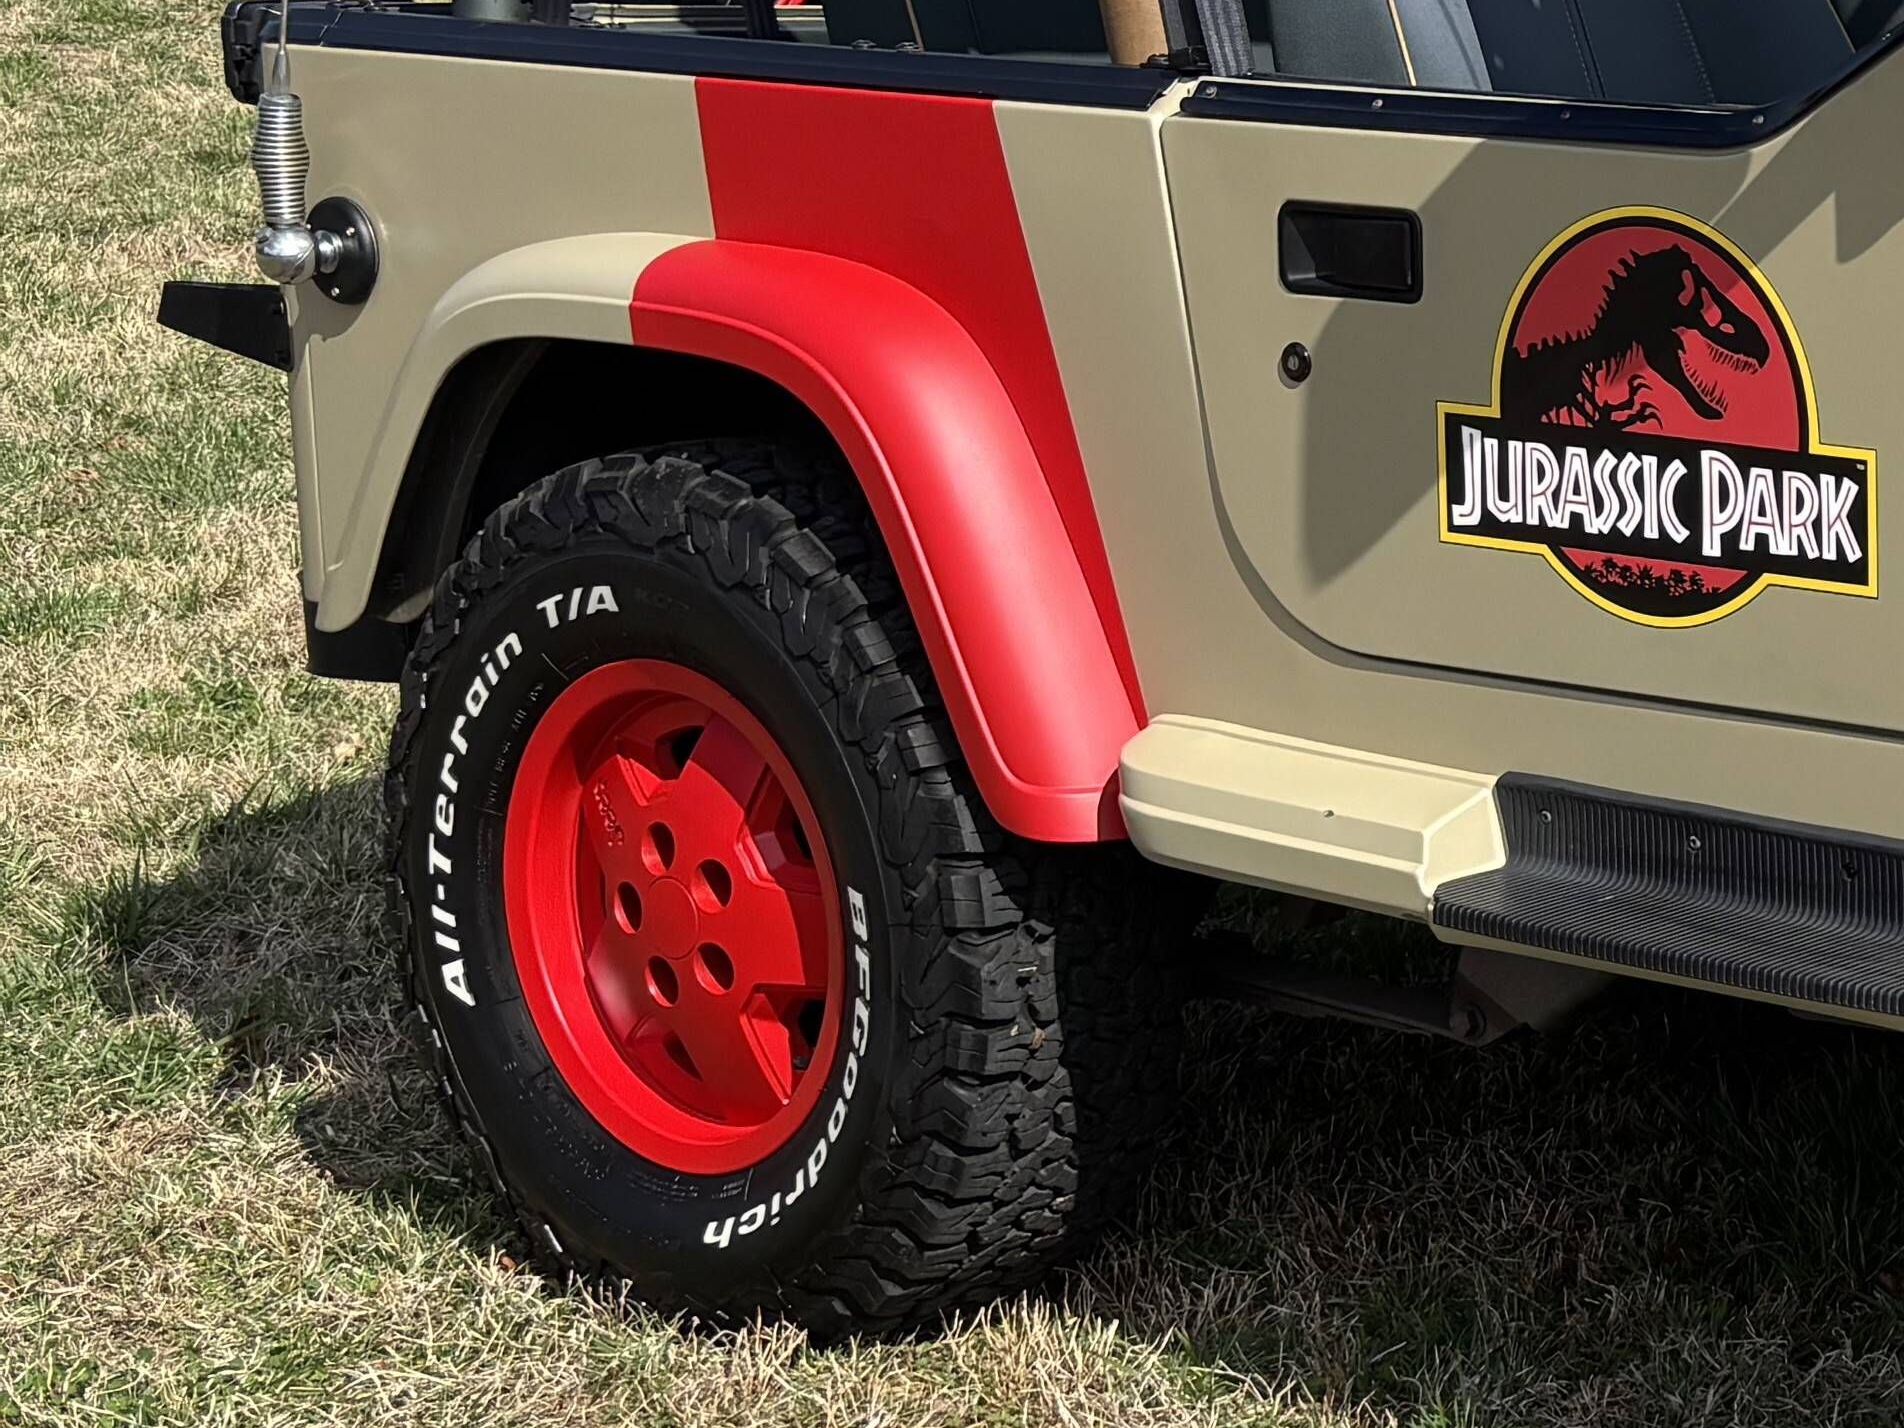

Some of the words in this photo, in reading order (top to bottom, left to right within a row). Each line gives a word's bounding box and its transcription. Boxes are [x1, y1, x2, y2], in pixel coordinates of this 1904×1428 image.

[1451, 425, 1691, 544] JURASSIC
[1699, 449, 1863, 564] PARK
[428, 625, 524, 1008] All-Terrain
[536, 585, 620, 630] T/A
[702, 884, 871, 1250] BFGoodrich
